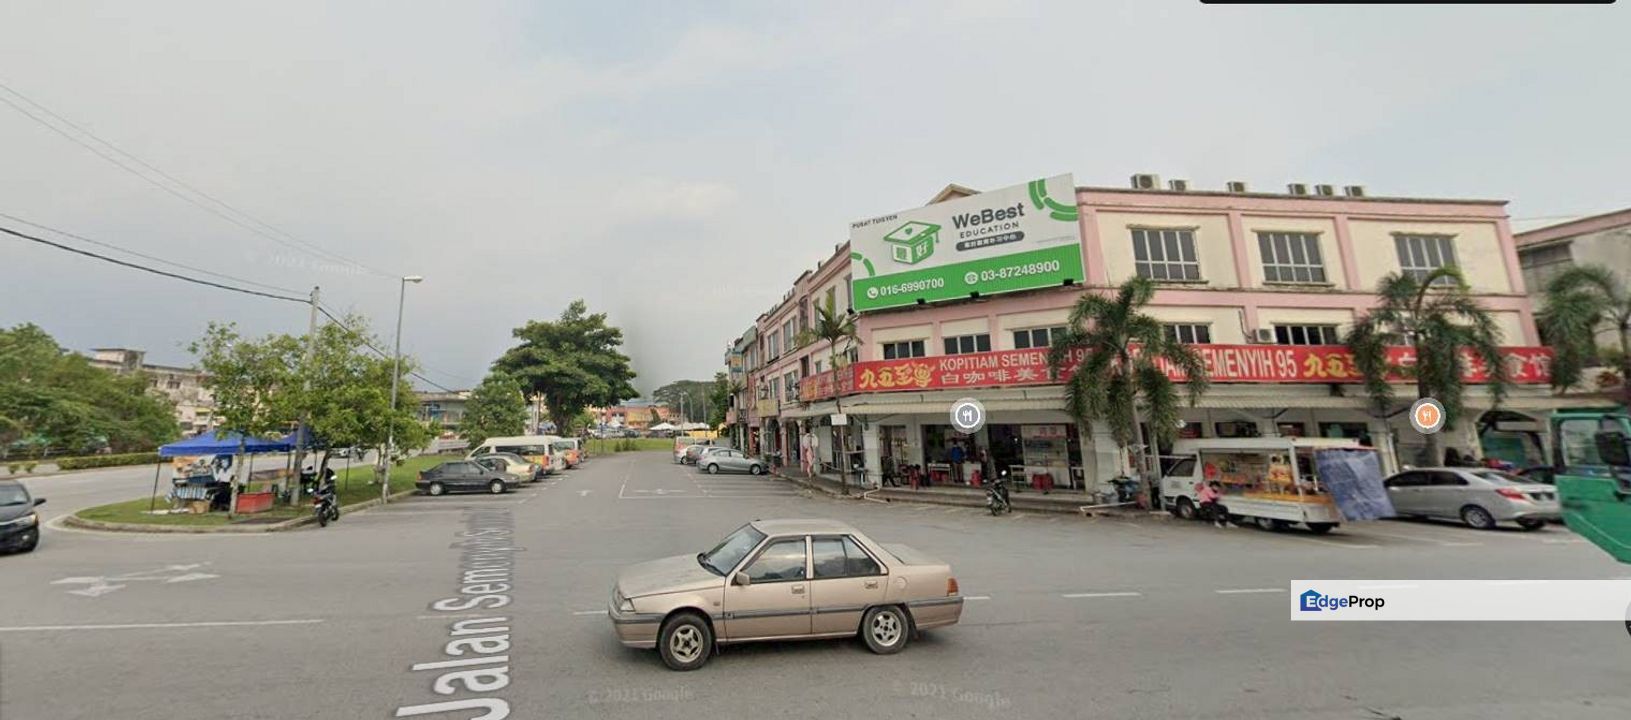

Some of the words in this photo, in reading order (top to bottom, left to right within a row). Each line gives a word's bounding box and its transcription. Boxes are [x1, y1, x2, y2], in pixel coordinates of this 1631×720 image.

[851, 221, 871, 229] PUSAT
[872, 214, 898, 225] TUISYEN
[952, 202, 1025, 229] WeBest
[960, 221, 1019, 239] EDUCATION
[981, 260, 1060, 281] 03-87248900
[880, 278, 944, 296] 016-6990700
[940, 356, 998, 371] KOPITIAM
[1001, 347, 1073, 367] SEMENH
[1277, 350, 1297, 378] 95
